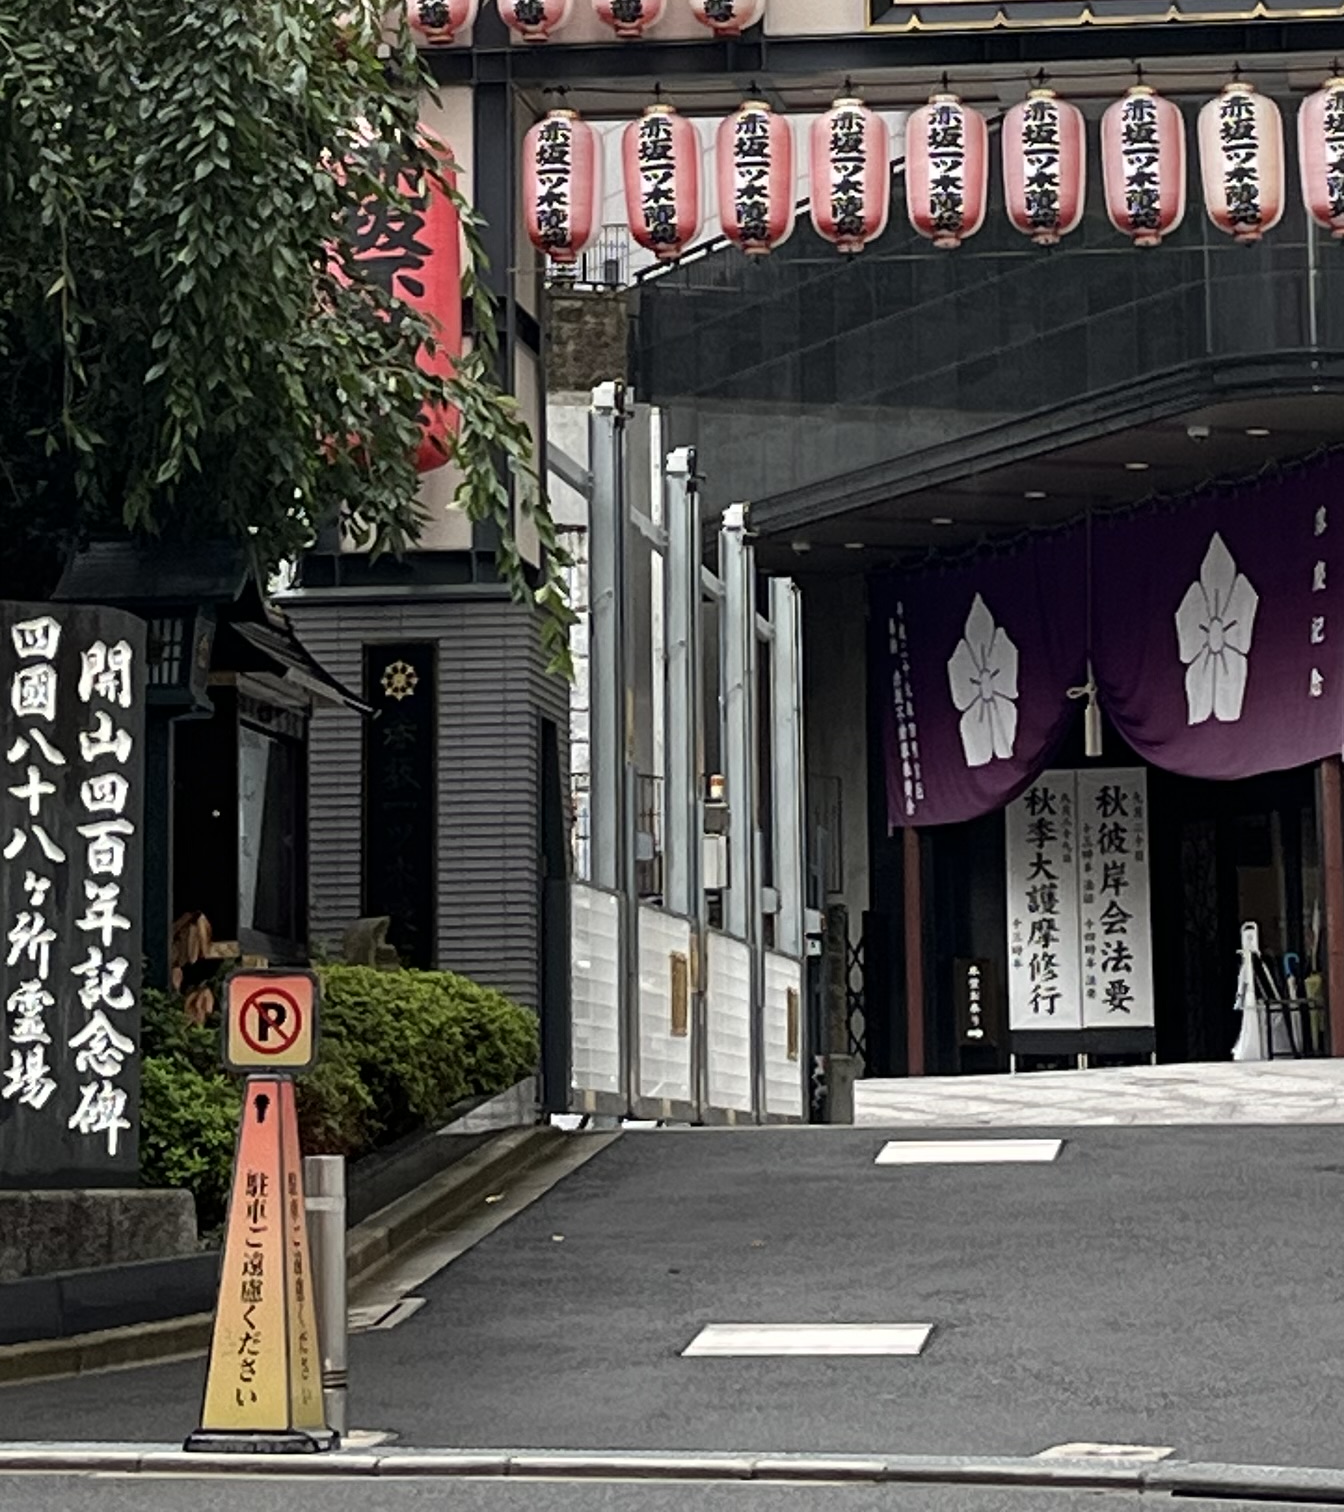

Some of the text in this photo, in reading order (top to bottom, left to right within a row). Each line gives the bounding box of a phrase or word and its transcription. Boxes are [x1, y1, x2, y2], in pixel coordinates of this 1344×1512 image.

[68, 640, 135, 1156] 開山四百年記念碑
[1024, 787, 1061, 1016] 秋季大護摩修行
[1096, 785, 1134, 1014] 秋彼岸会法要
[237, 1172, 268, 1406] 駐車ご遠慮ください
